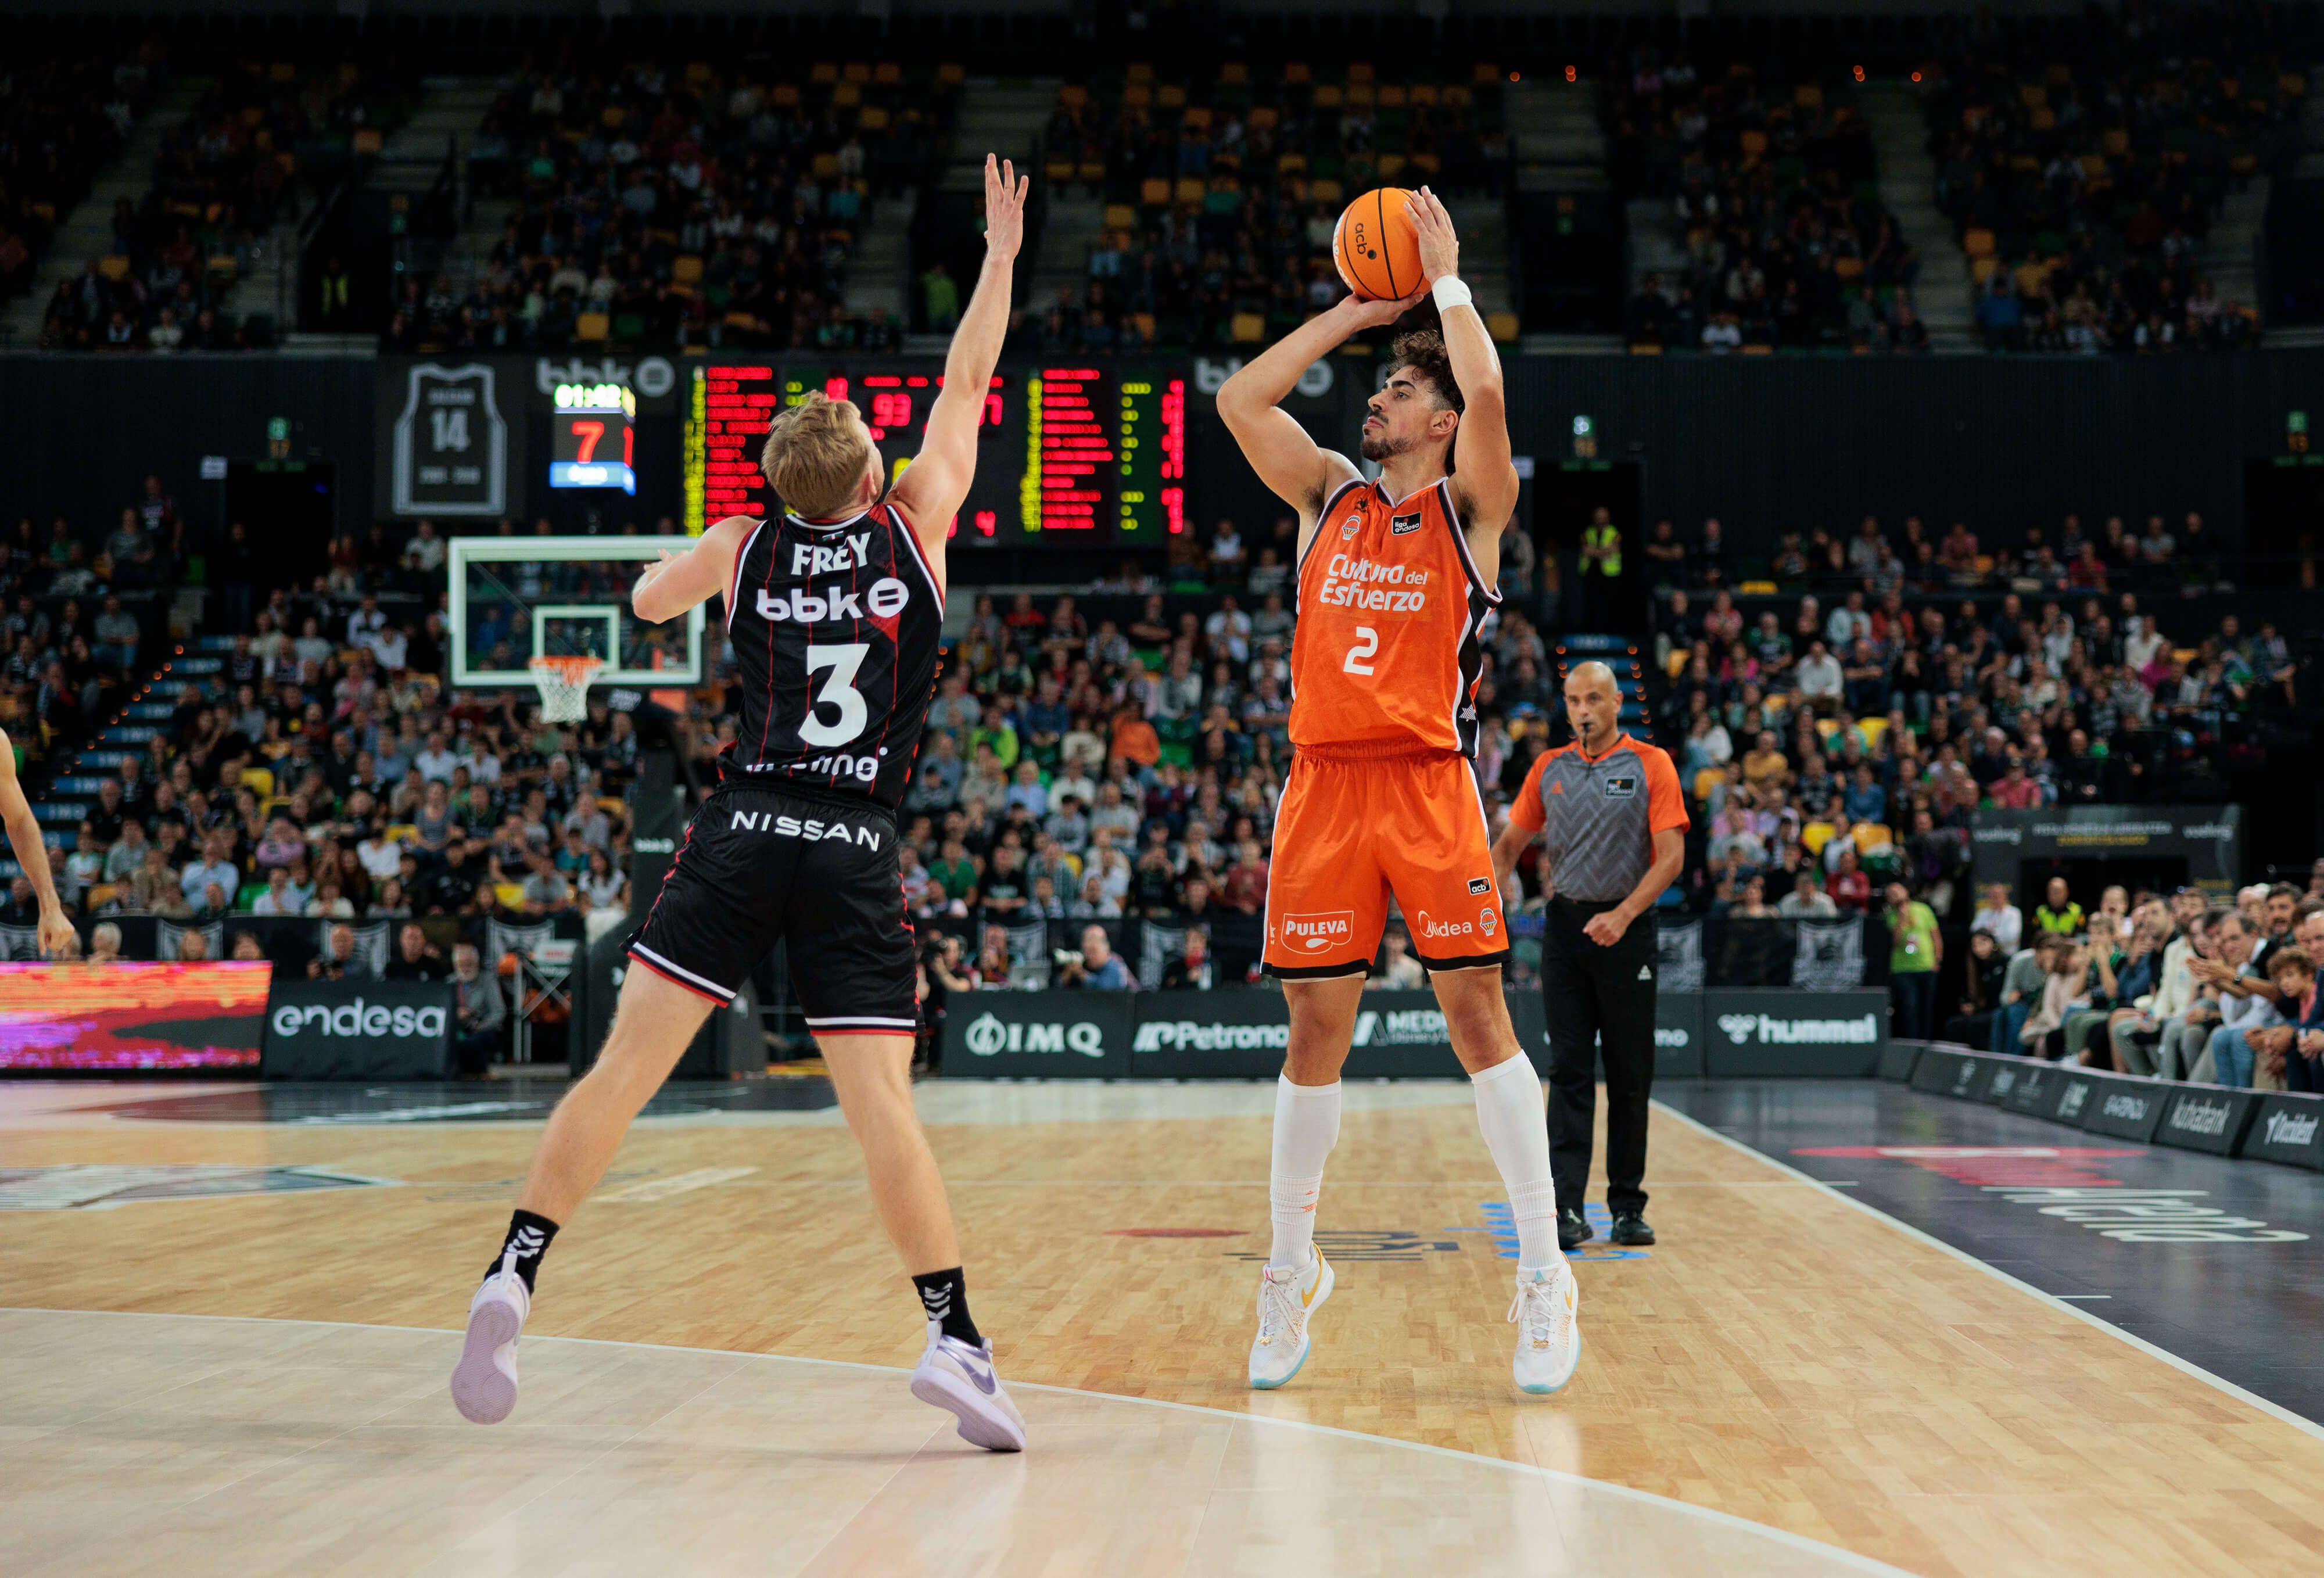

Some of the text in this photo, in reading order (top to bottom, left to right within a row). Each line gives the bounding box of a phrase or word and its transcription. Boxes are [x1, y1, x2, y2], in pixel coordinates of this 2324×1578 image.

[1355, 223, 1367, 254] acb
[431, 408, 471, 452] 14
[571, 421, 605, 464] 7
[1395, 523, 1419, 533] endesa
[1328, 554, 1428, 585] Cultura del
[756, 586, 864, 622] bbk
[1319, 578, 1425, 611] Esfuerzo
[1343, 626, 1379, 676] 2
[798, 643, 870, 747] 3
[731, 810, 880, 852] NISSAN
[1472, 884, 1486, 893] acb
[1286, 920, 1348, 936] PULEVA
[1418, 910, 1473, 938] Midea
[272, 996, 447, 1038] endesa
[1758, 1013, 1878, 1043] hummel
[1007, 1021, 1105, 1058] IMQ
[1174, 1020, 1290, 1051] Petrono
